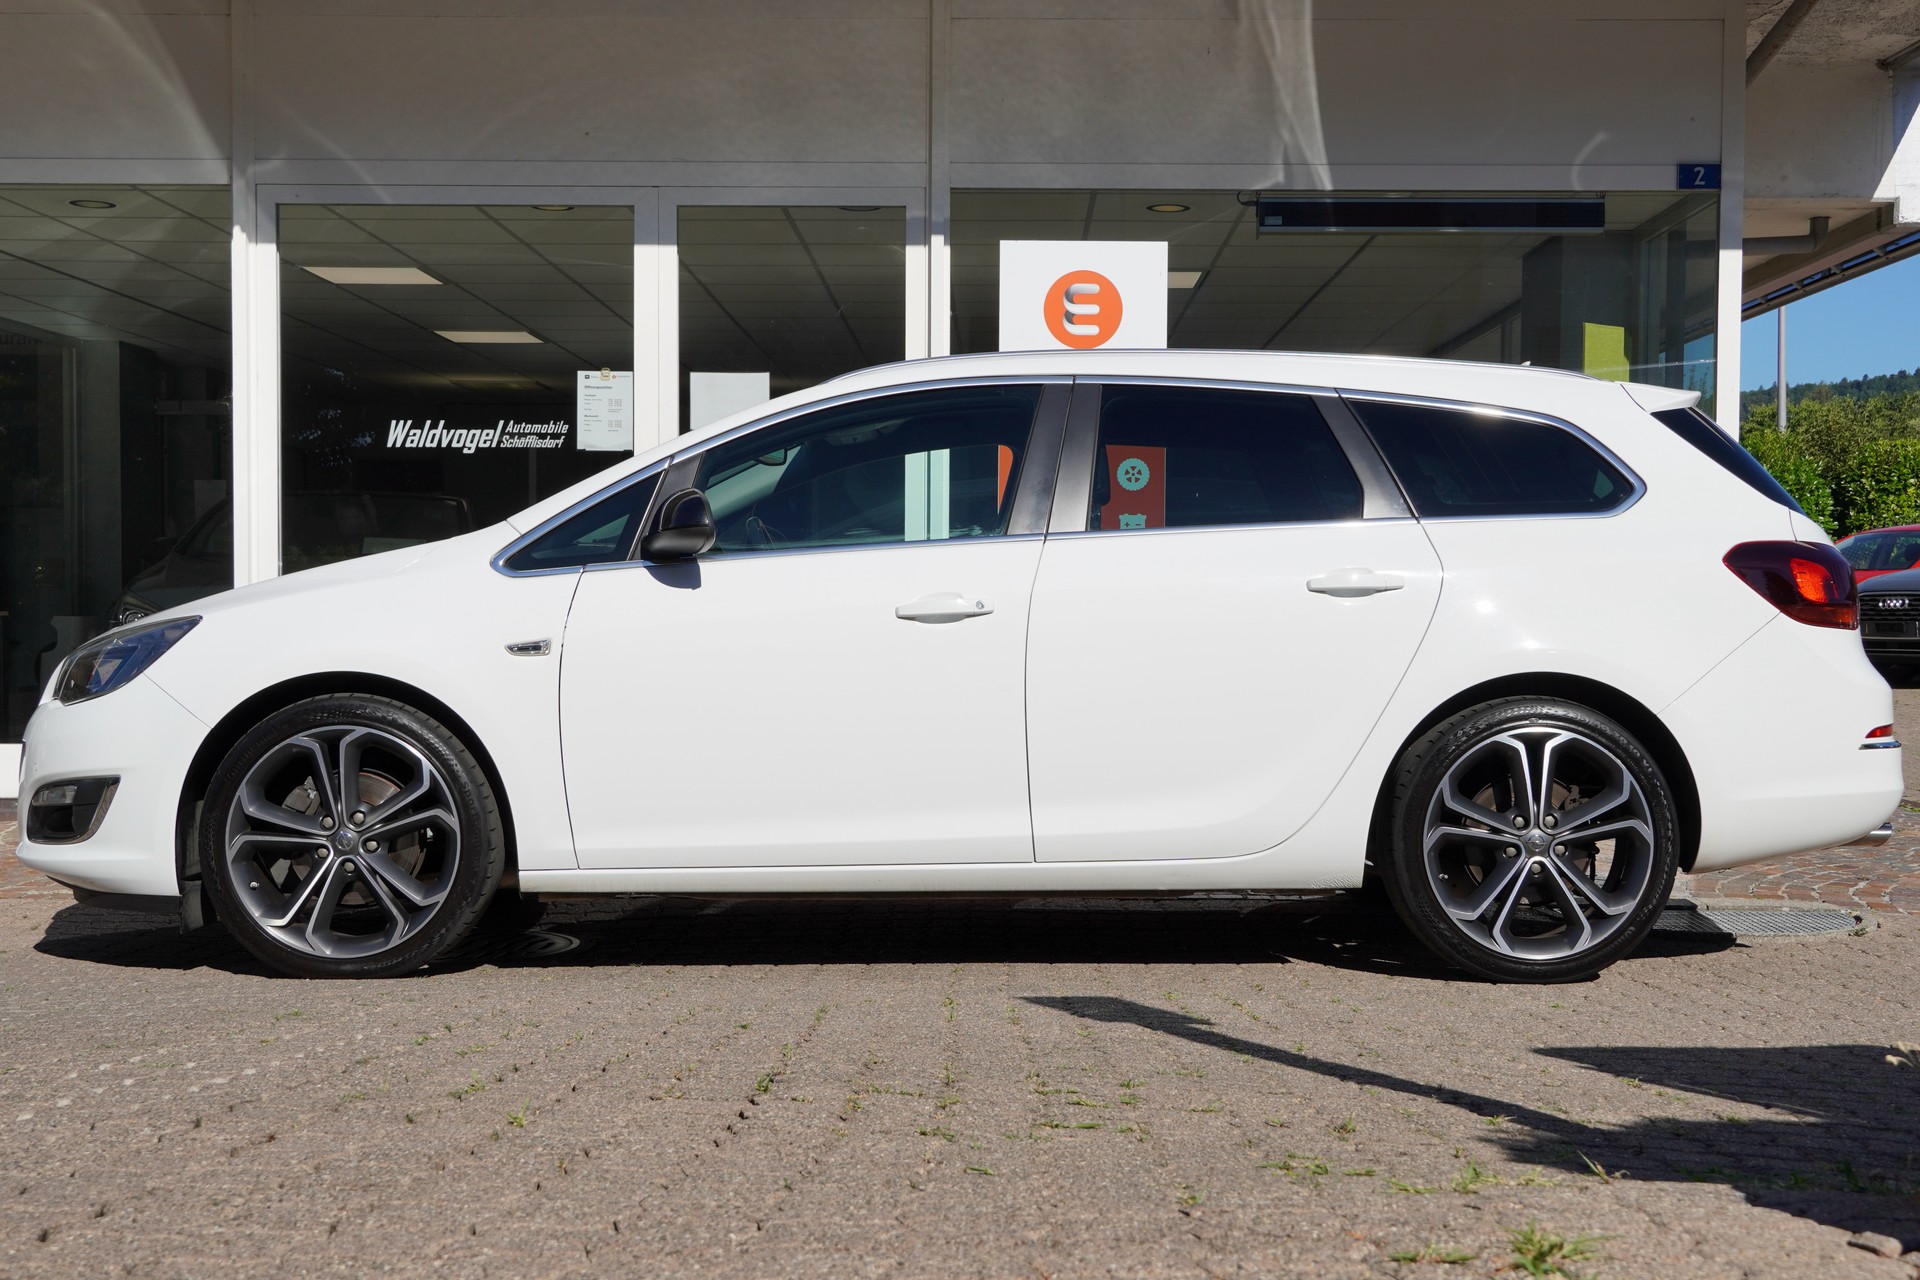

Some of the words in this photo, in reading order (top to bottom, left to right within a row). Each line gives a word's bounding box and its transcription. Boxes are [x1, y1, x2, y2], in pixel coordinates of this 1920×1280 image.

[1693, 166, 1706, 186] 2
[505, 420, 569, 434] Automobile
[386, 419, 505, 454] Waldvogel
[500, 435, 565, 449] Schöfflisdorf
